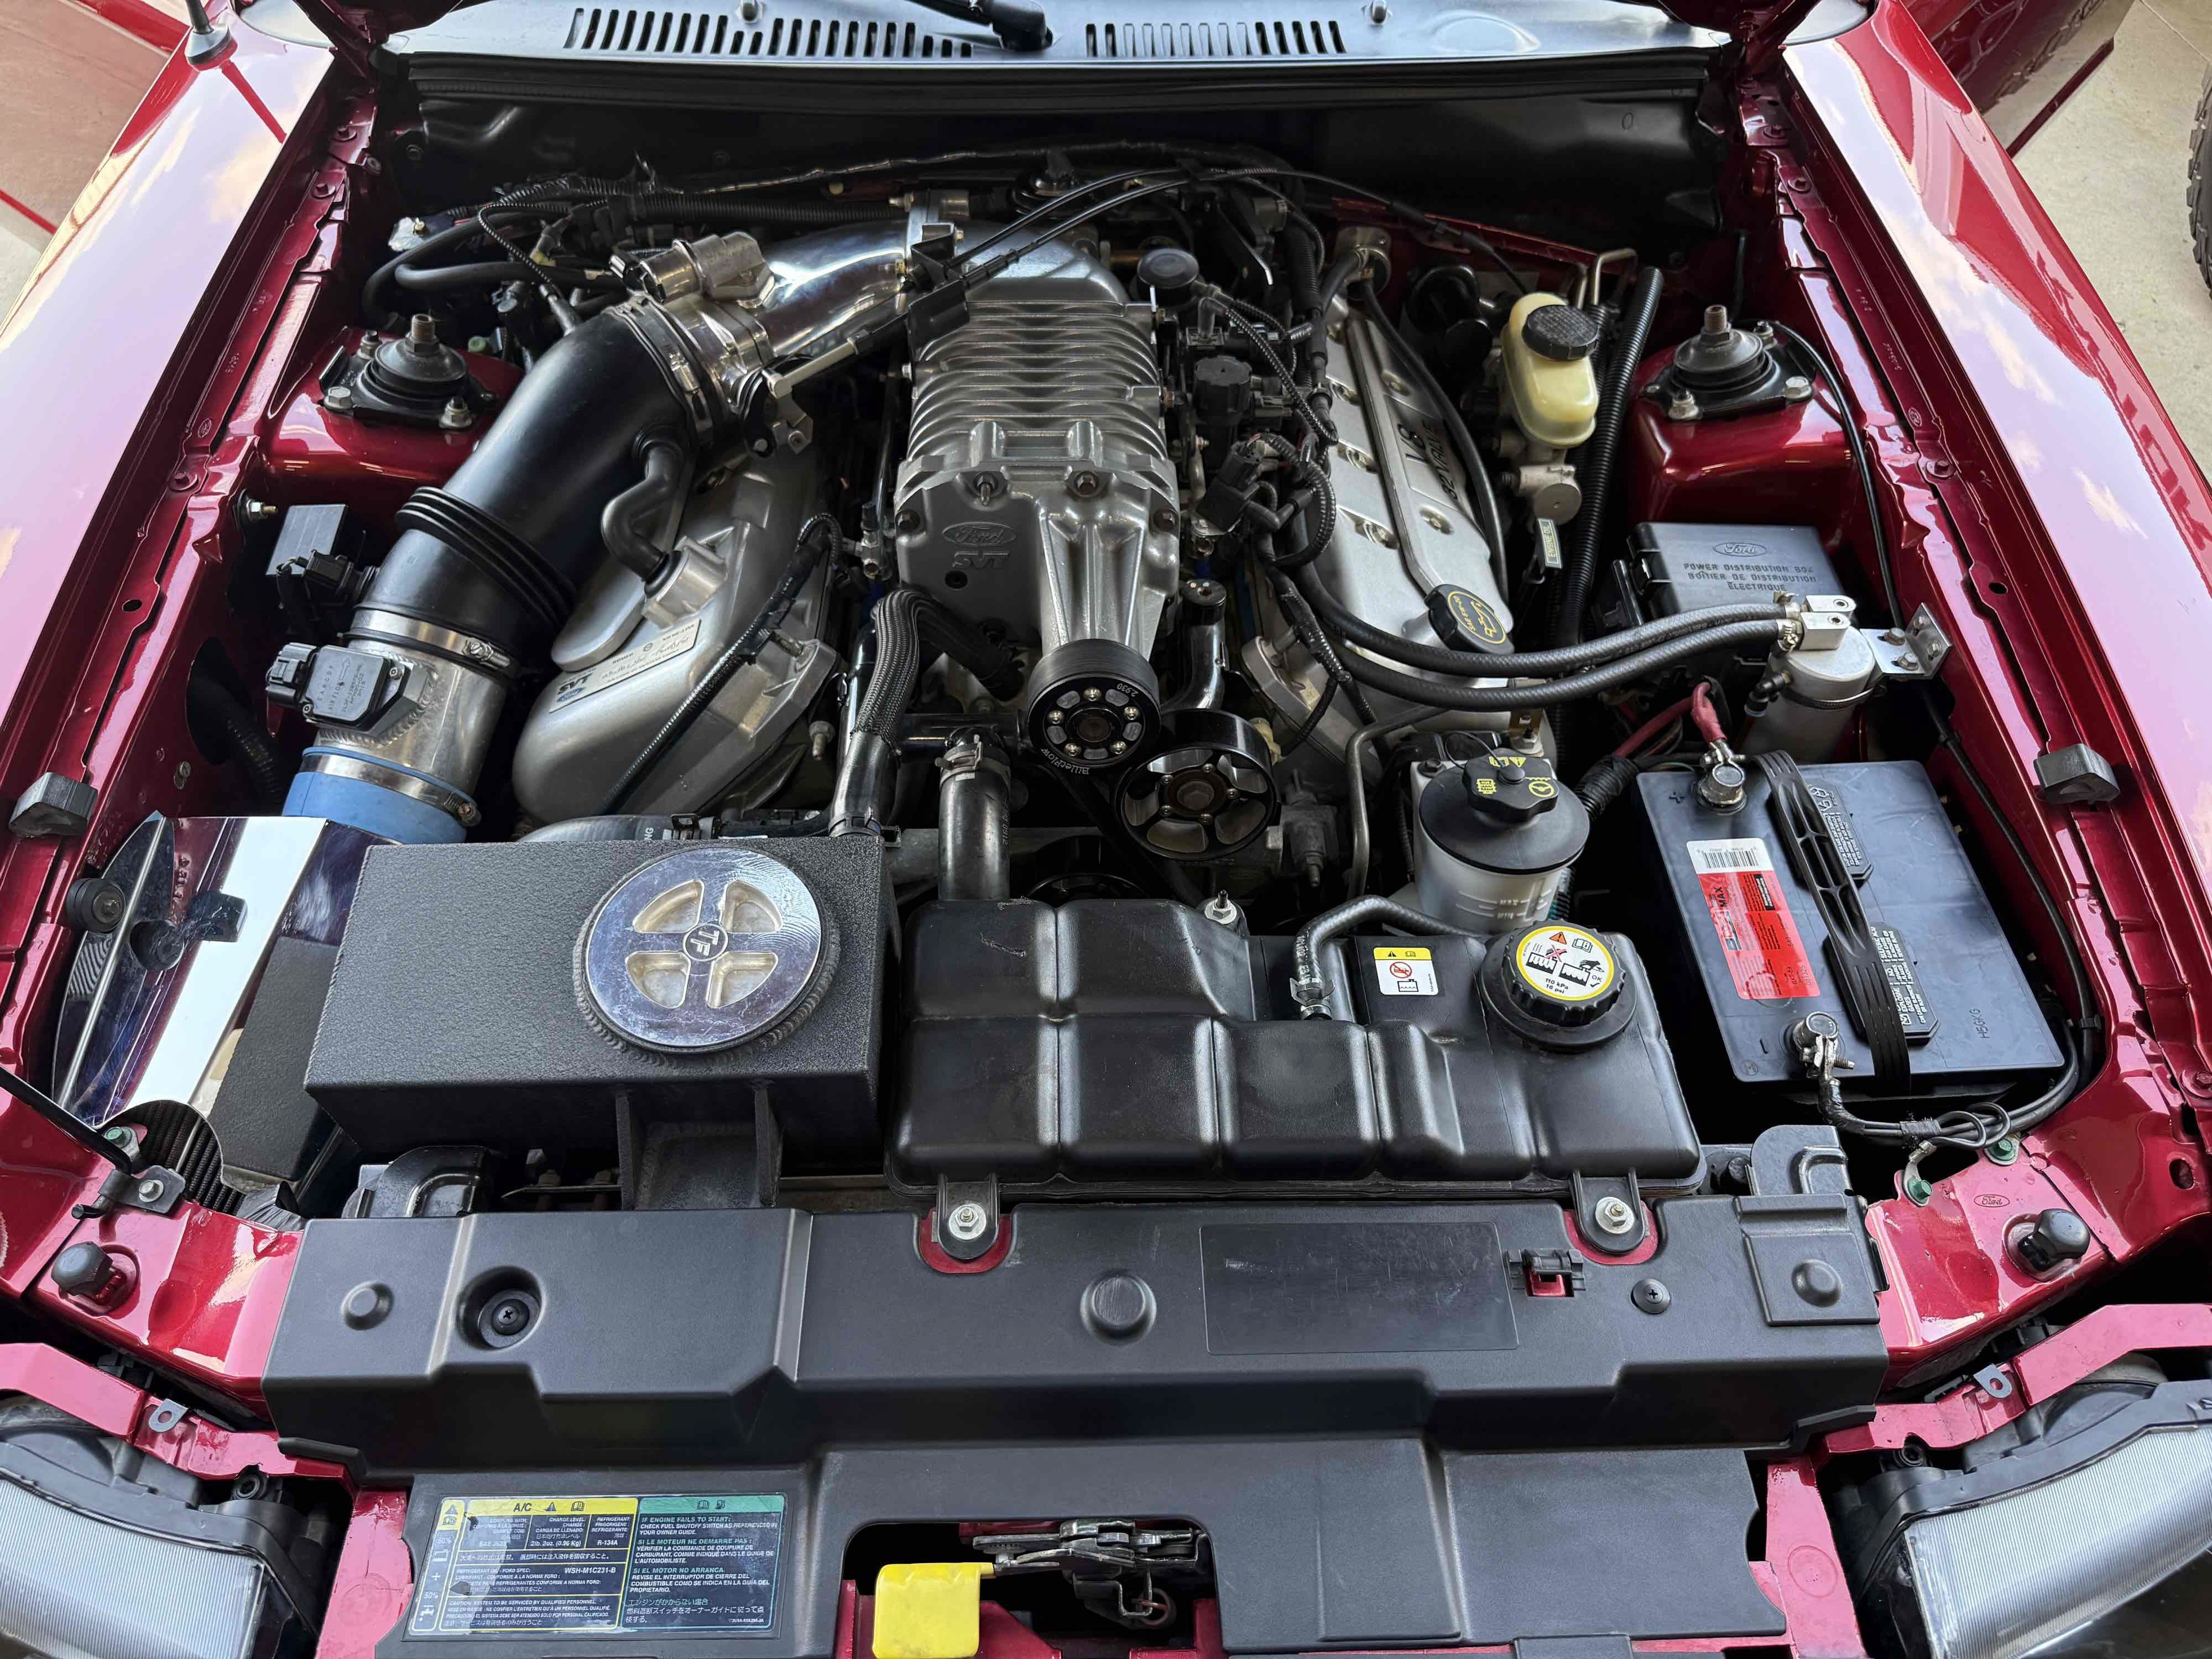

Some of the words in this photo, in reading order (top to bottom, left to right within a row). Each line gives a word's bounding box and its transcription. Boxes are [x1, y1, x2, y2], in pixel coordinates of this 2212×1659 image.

[1543, 534, 1557, 557] ENGINE
[1724, 544, 1756, 554] Ford
[951, 551, 1010, 570] SVT
[1724, 564, 1788, 572] DISTRIBUTION
[1752, 574, 1817, 582] DISTRIBUTION
[557, 672, 593, 695] SVT
[1715, 886, 1728, 909] MAX
[1886, 968, 1895, 977] NO
[1557, 982, 1569, 990] kPa
[1893, 987, 1907, 1013] EXPLOSIVE
[1904, 997, 1914, 1012] GASES
[513, 1503, 533, 1512] A/C
